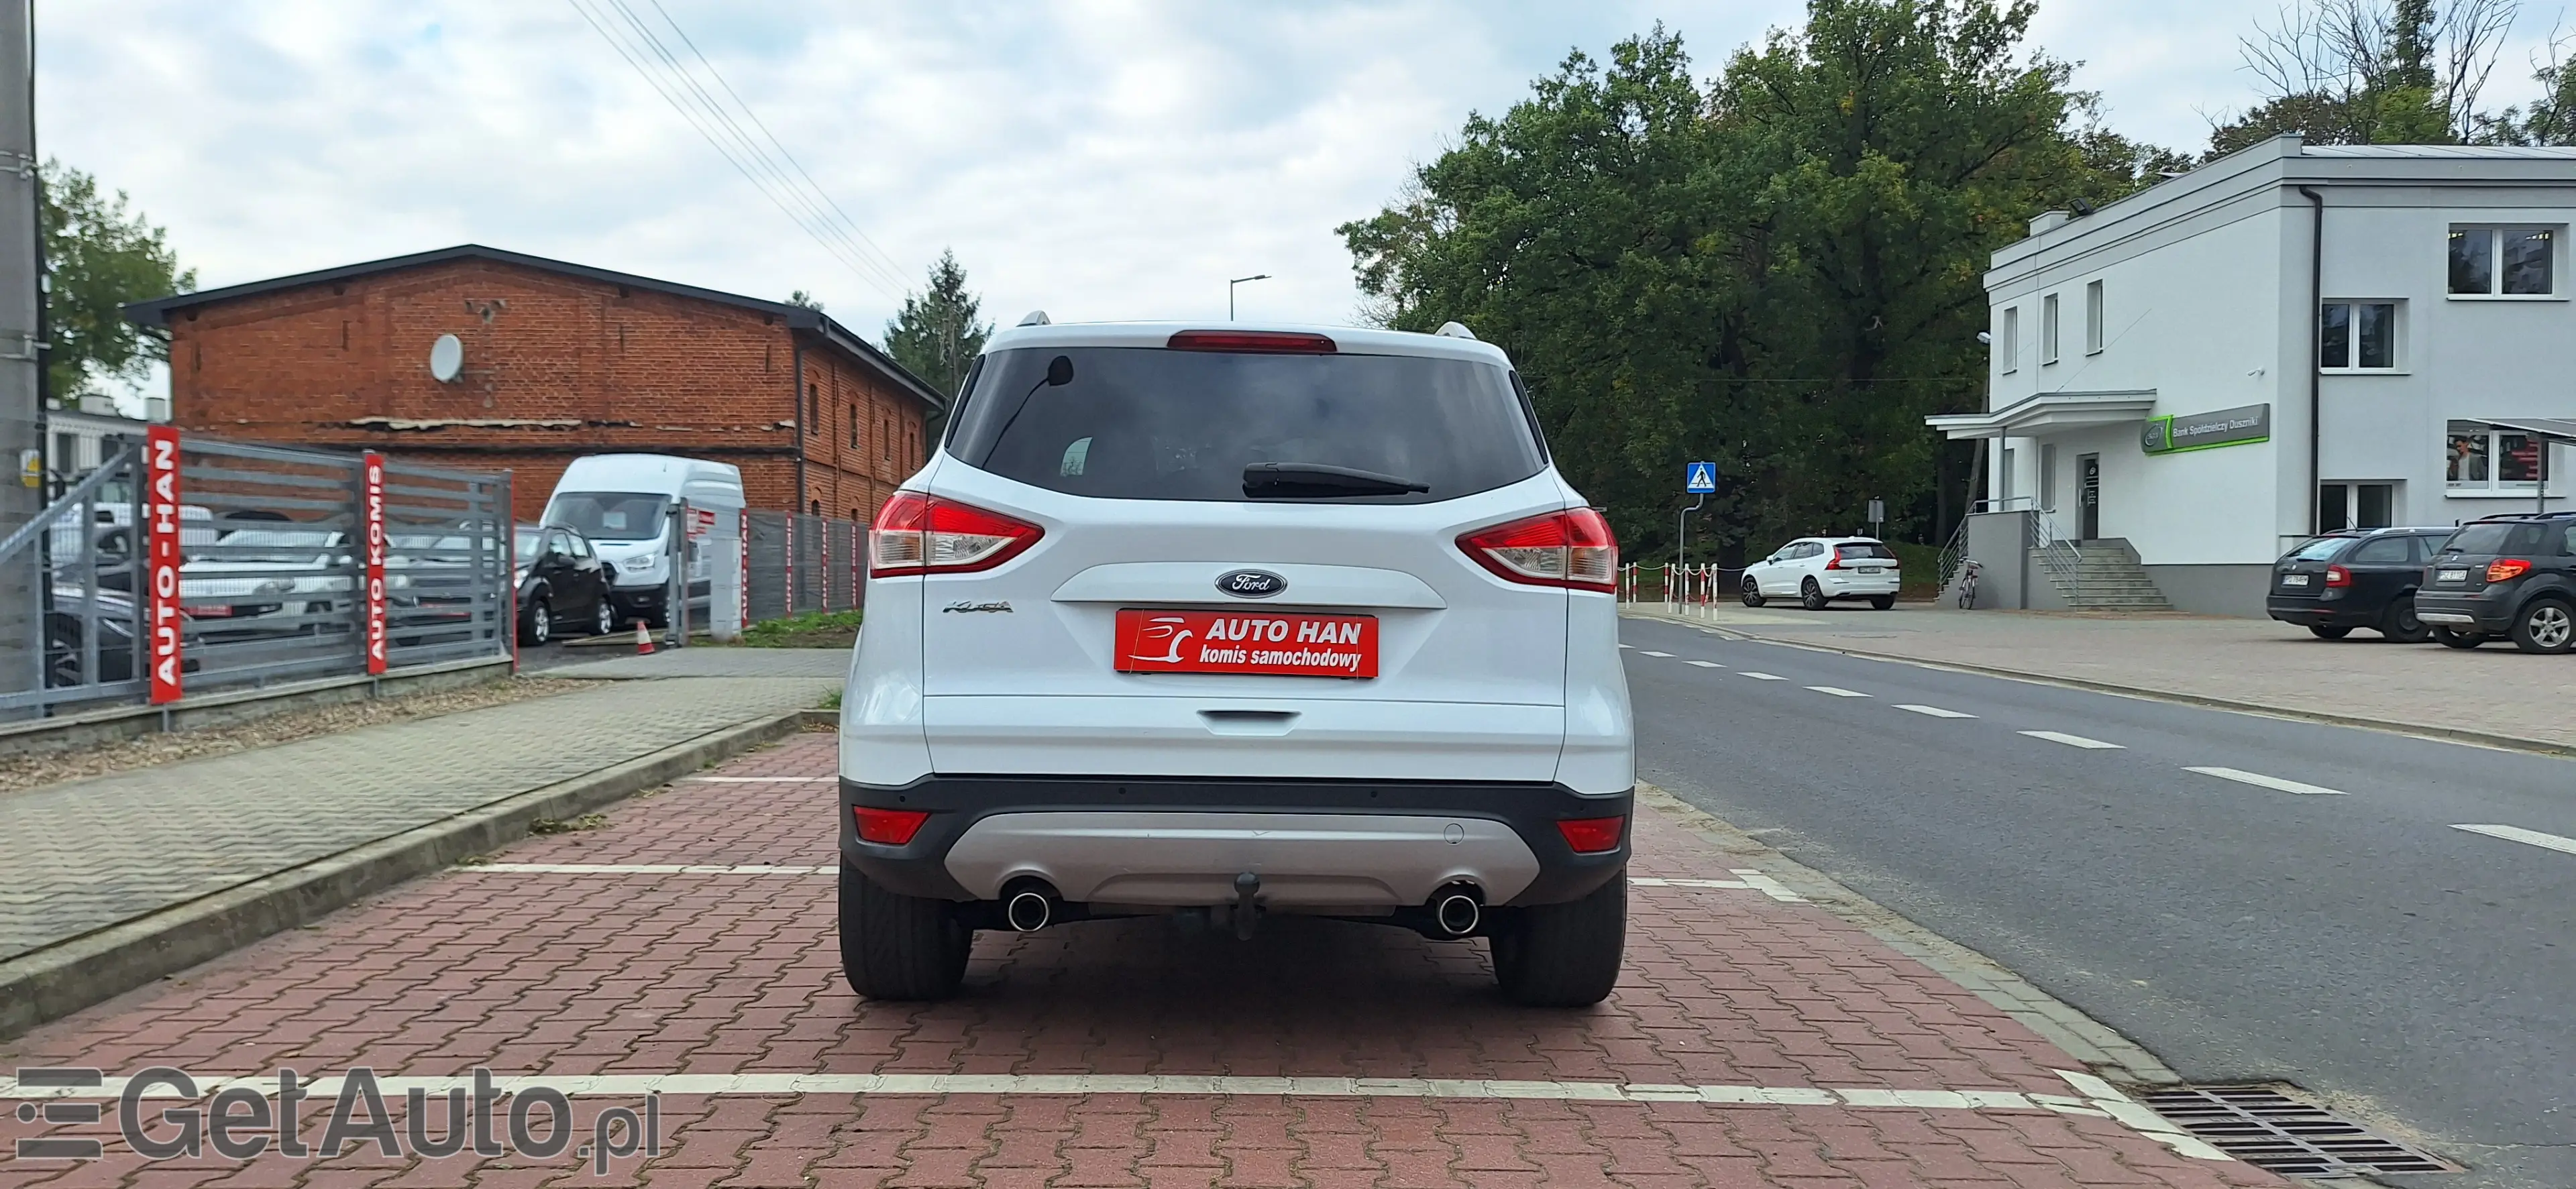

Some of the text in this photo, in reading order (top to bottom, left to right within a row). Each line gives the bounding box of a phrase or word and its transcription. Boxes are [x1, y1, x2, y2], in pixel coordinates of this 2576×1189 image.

[2173, 428, 2188, 437] Bank
[2229, 416, 2259, 429] Duszniki
[154, 439, 176, 687] AUTO-HAN
[368, 465, 384, 661] AUTO KOMIS
[1231, 573, 1270, 591] Ford
[1205, 618, 1362, 645] AUTO HAN
[1199, 644, 1362, 672] komis samochodowy
